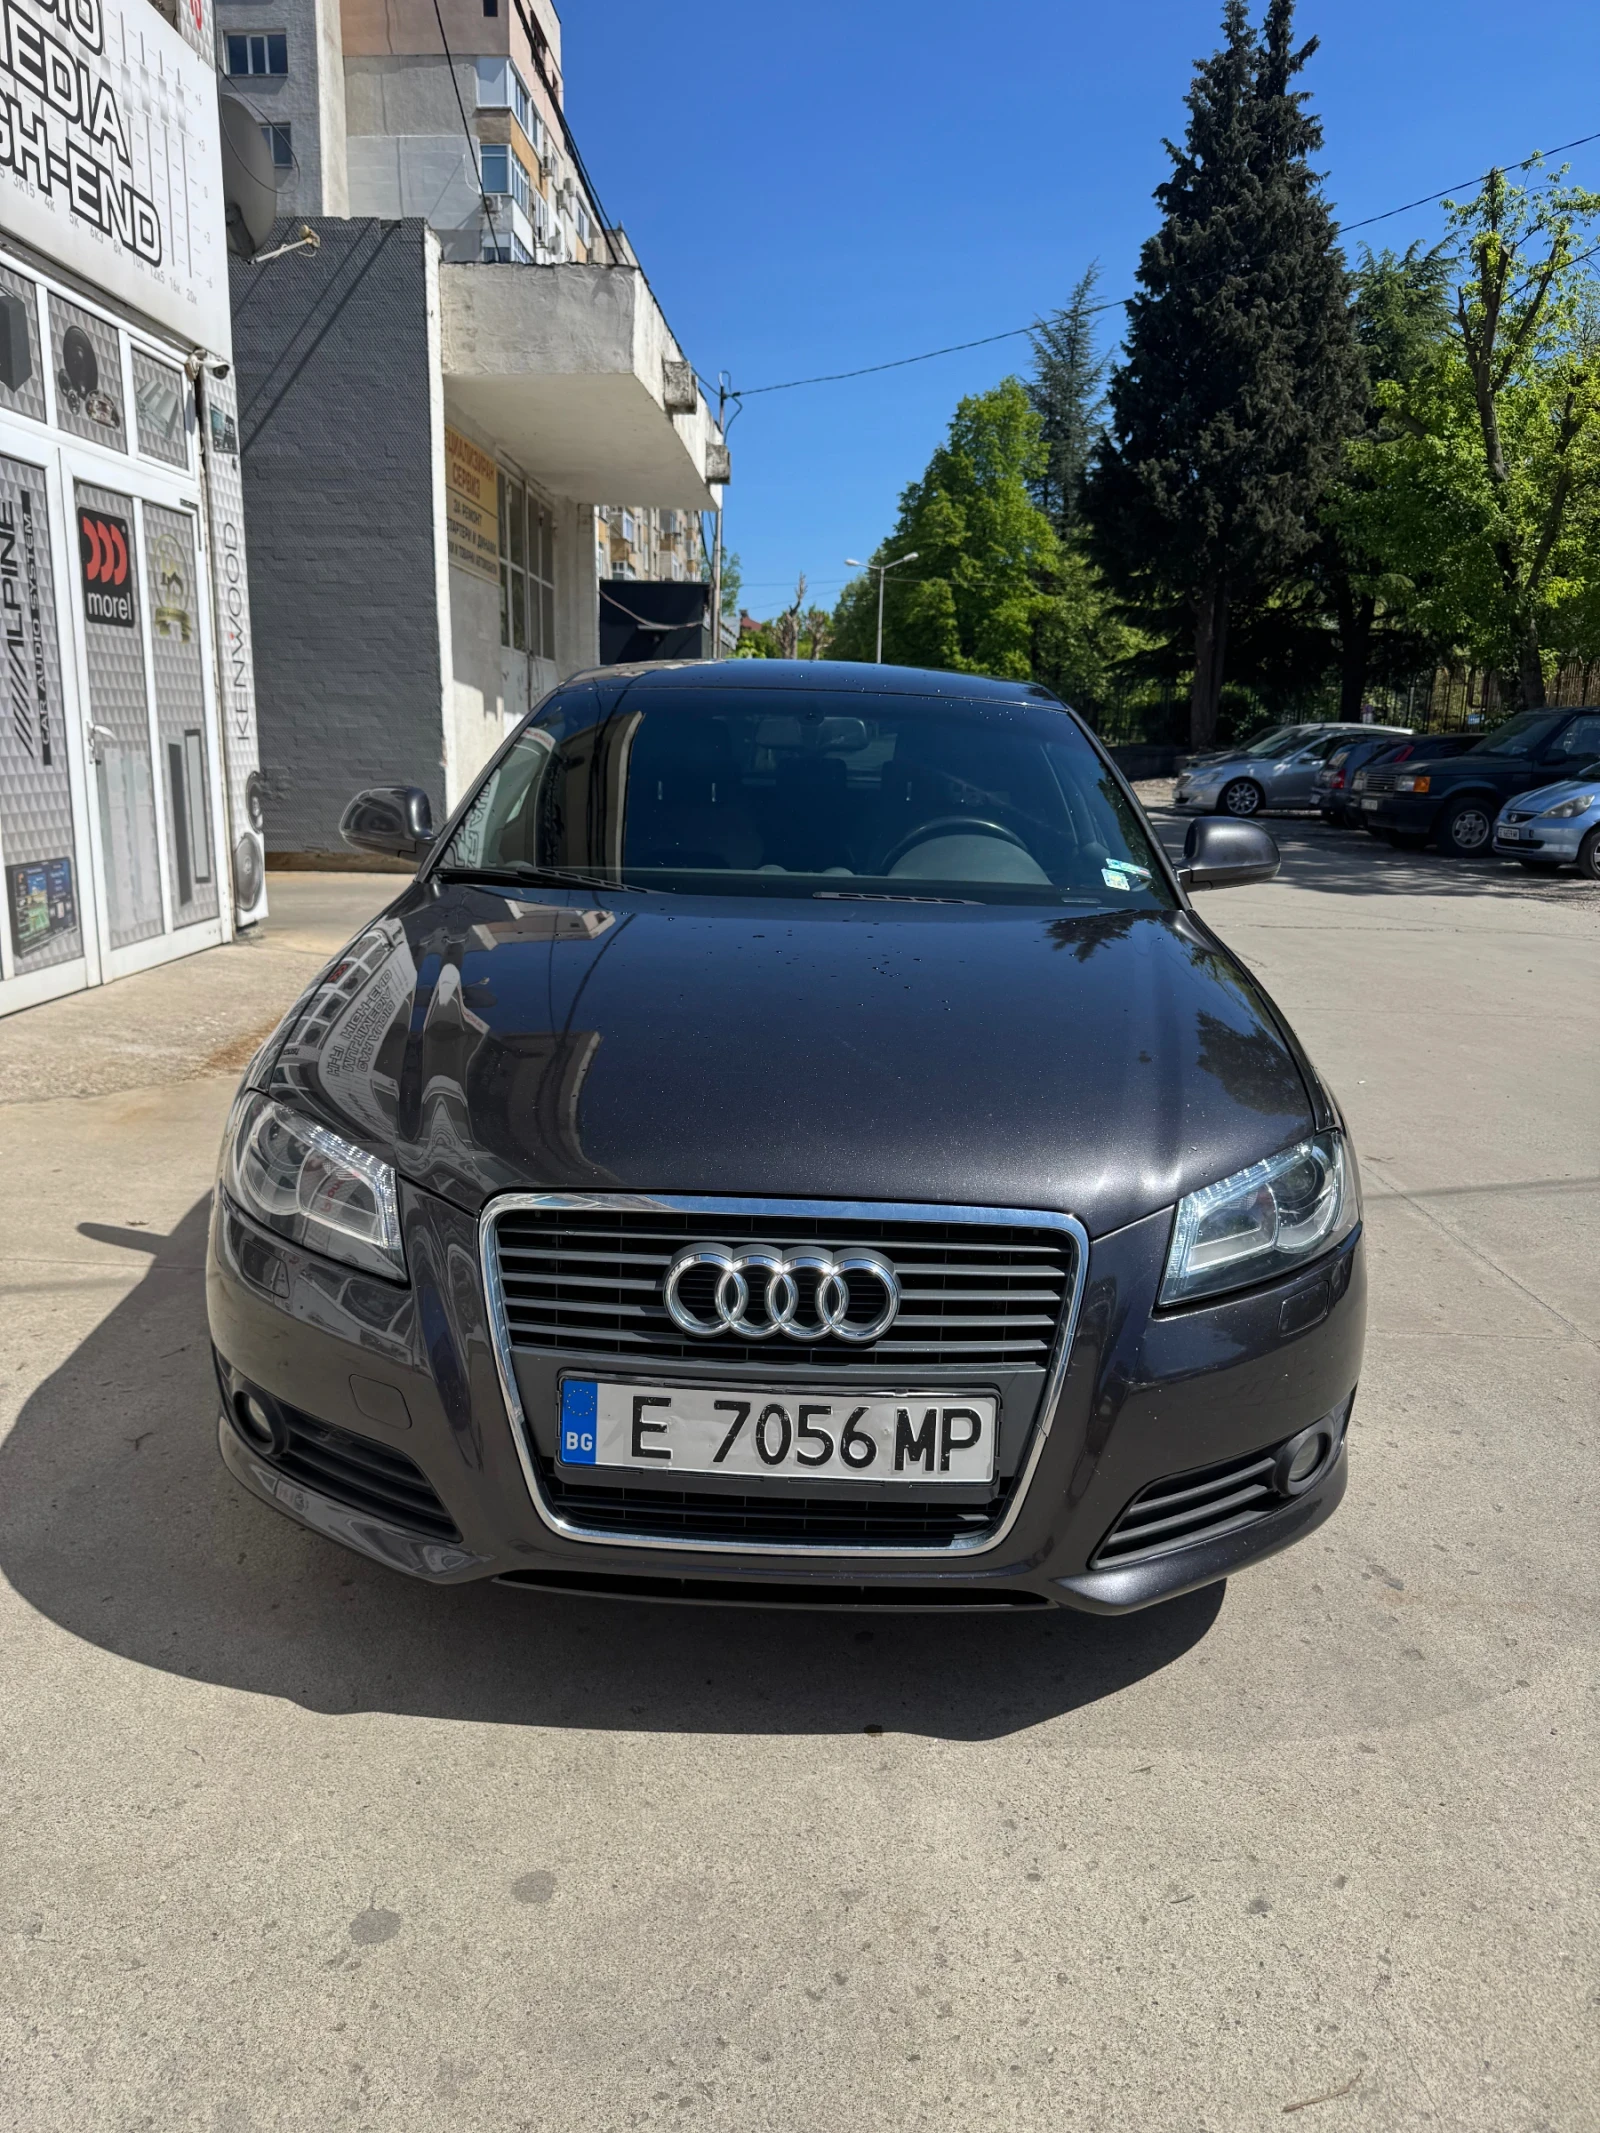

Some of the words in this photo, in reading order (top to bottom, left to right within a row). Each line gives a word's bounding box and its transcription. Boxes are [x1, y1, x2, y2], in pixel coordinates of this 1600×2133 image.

[0, 0, 131, 169] EDIA
[452, 462, 480, 500] СЕРВИЗ
[462, 502, 482, 527] РЕМОНТ
[0, 500, 27, 680] ALPINE
[24, 513, 39, 610] SYSTEM
[87, 592, 132, 620] morel
[224, 522, 250, 740] KENWOOD
[32, 618, 46, 691] AUDIO
[40, 700, 50, 745] CAR
[566, 1432, 593, 1452] BG
[631, 1396, 673, 1460] E
[713, 1400, 878, 1468] 7056
[894, 1407, 982, 1473] MP
